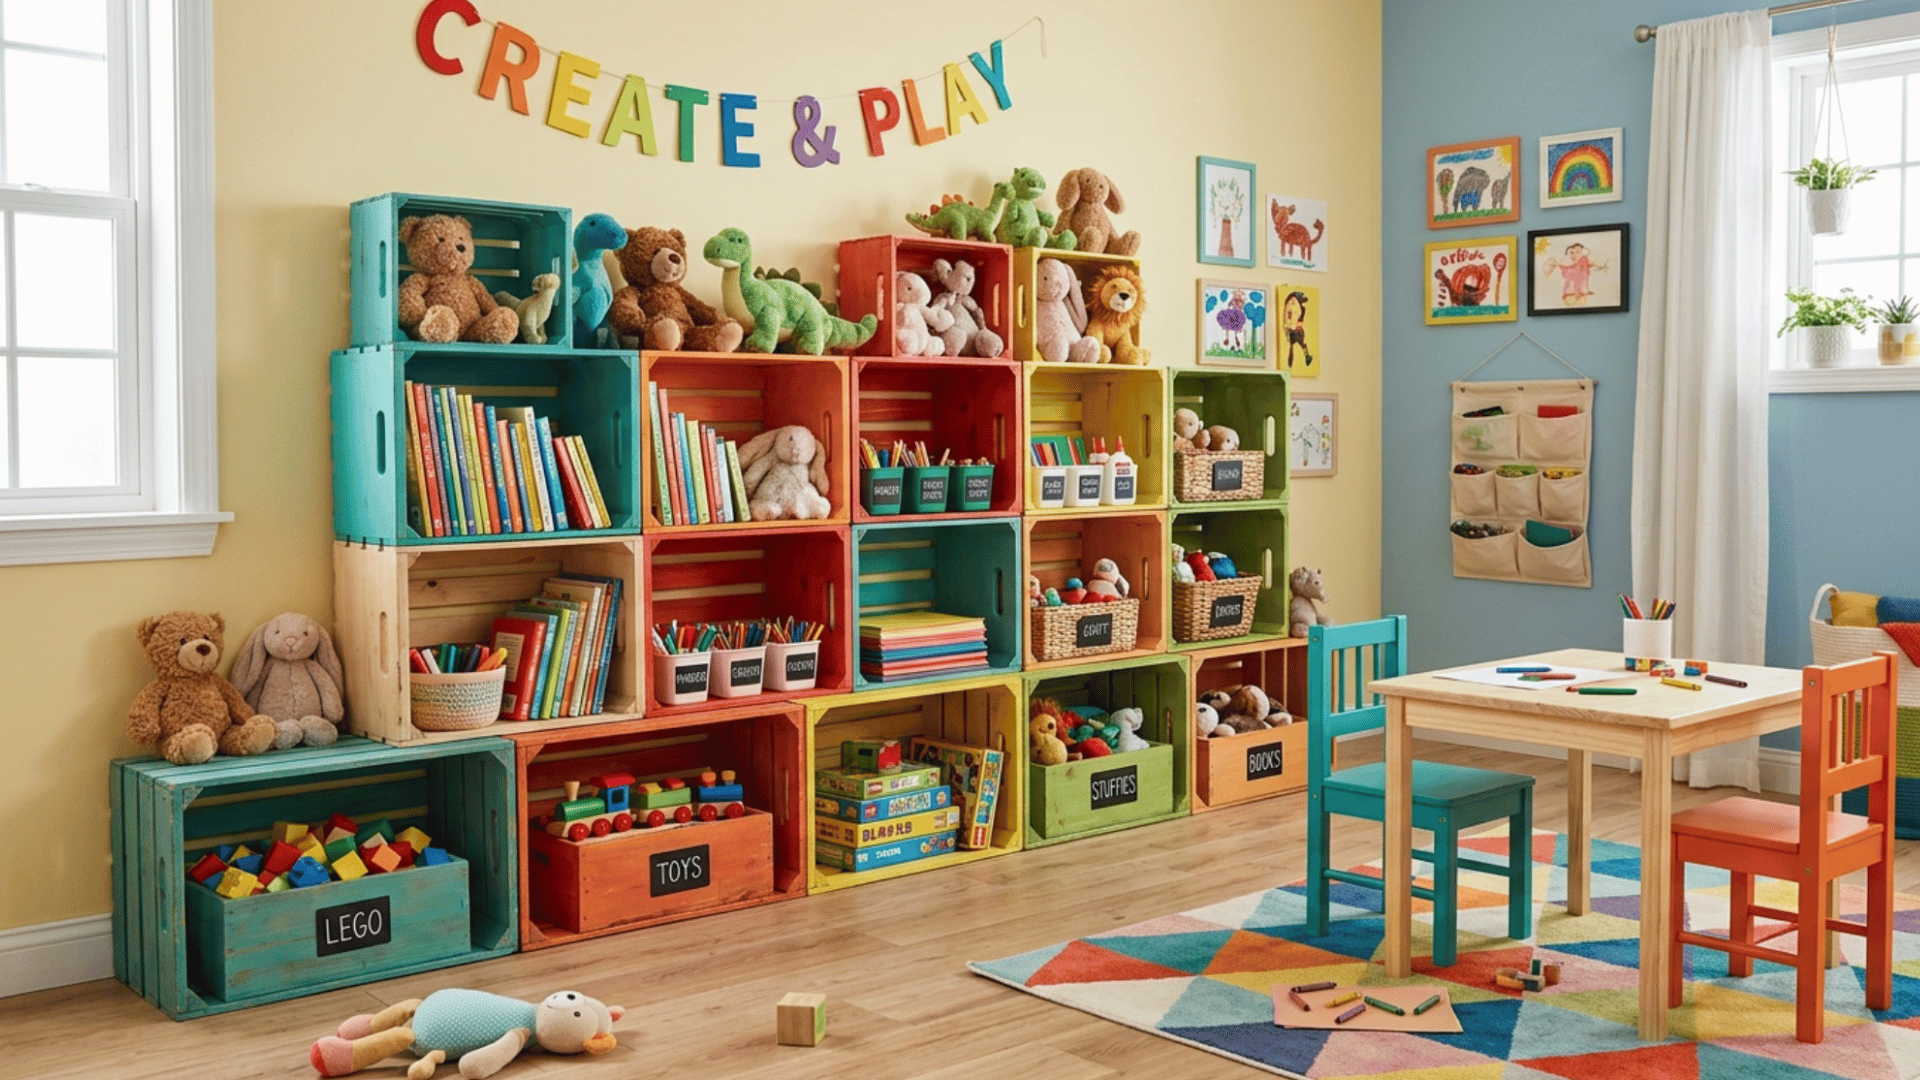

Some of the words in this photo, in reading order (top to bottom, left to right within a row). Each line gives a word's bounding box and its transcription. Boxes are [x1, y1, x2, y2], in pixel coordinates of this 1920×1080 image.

[415, 0, 761, 168] CREATE
[791, 94, 841, 168] &
[858, 39, 1013, 157] PLAY
[1249, 749, 1281, 773] BOOKS
[1092, 774, 1136, 800] STUFFIES
[656, 855, 702, 885] TOYS
[325, 908, 383, 945] LEGO
